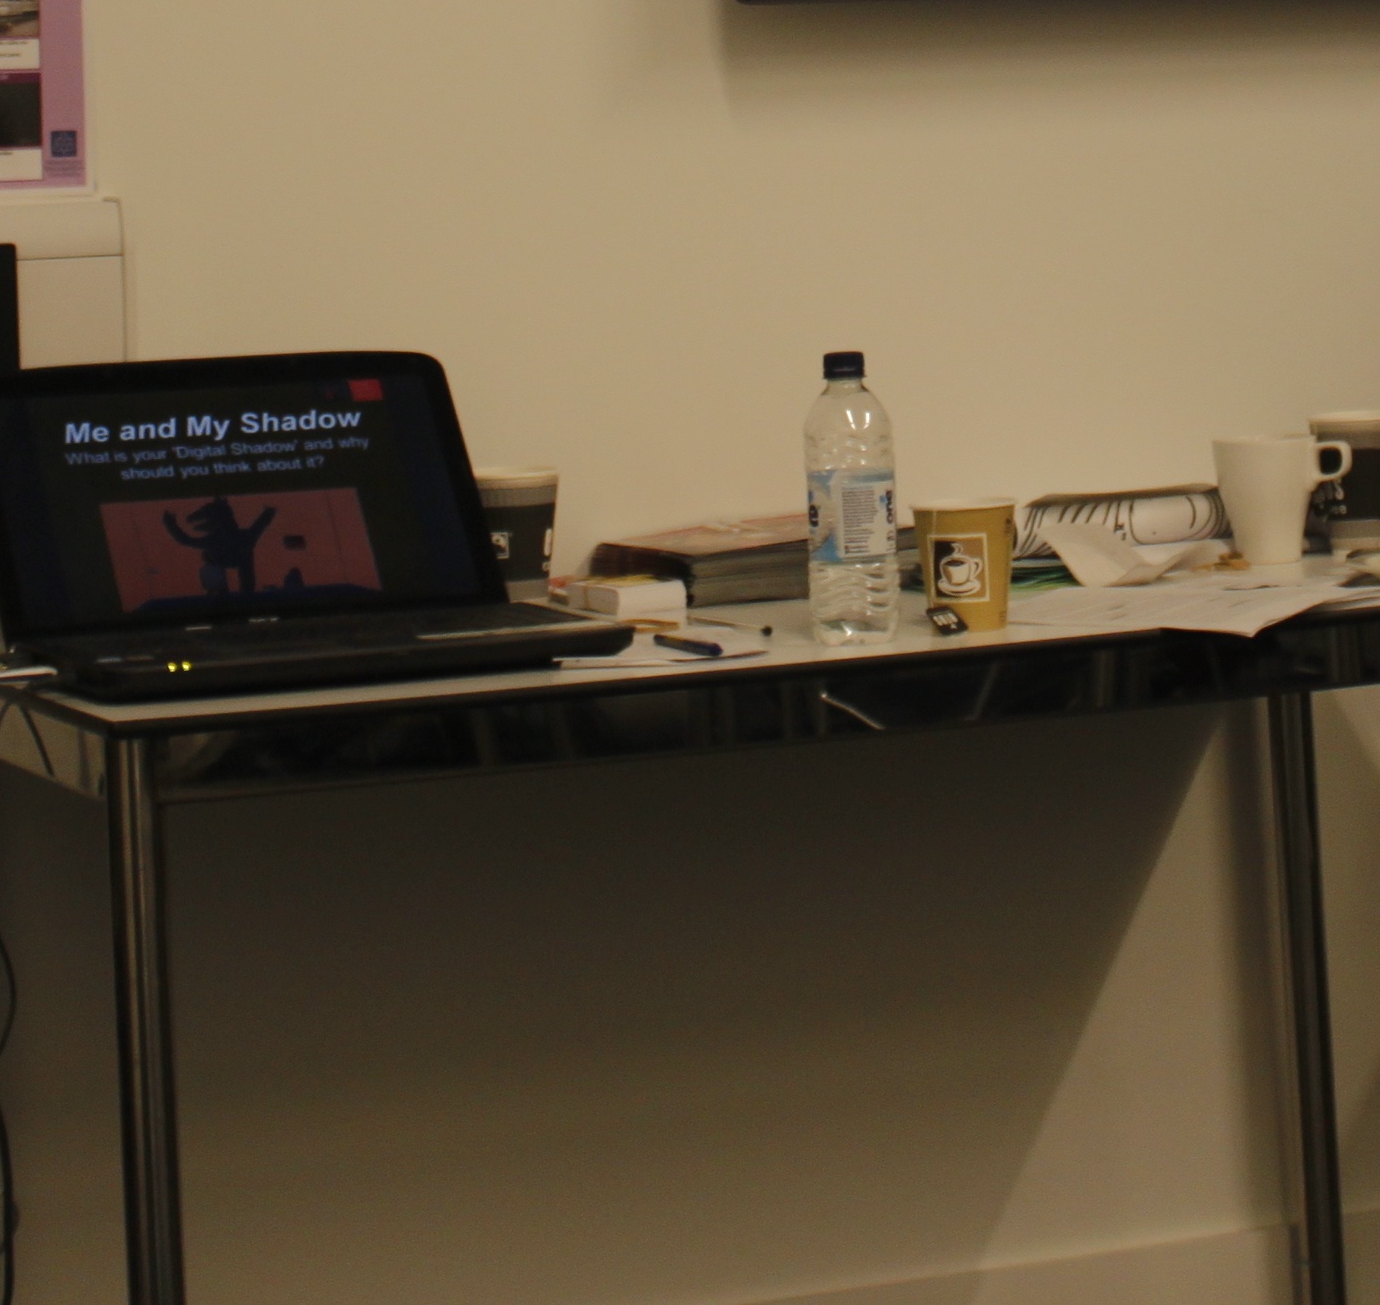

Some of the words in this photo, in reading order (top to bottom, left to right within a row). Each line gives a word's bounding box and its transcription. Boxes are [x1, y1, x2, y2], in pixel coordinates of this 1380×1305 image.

[65, 422, 110, 443] Me
[119, 418, 177, 441] and
[186, 415, 230, 440] My
[240, 409, 362, 434] Shadow
[65, 451, 110, 465] What
[114, 451, 128, 463] is
[132, 450, 167, 467] your
[304, 438, 333, 451] and
[338, 436, 369, 451] why
[121, 465, 174, 480] should
[180, 464, 209, 479] you
[214, 460, 250, 474] think
[257, 458, 301, 472] about
